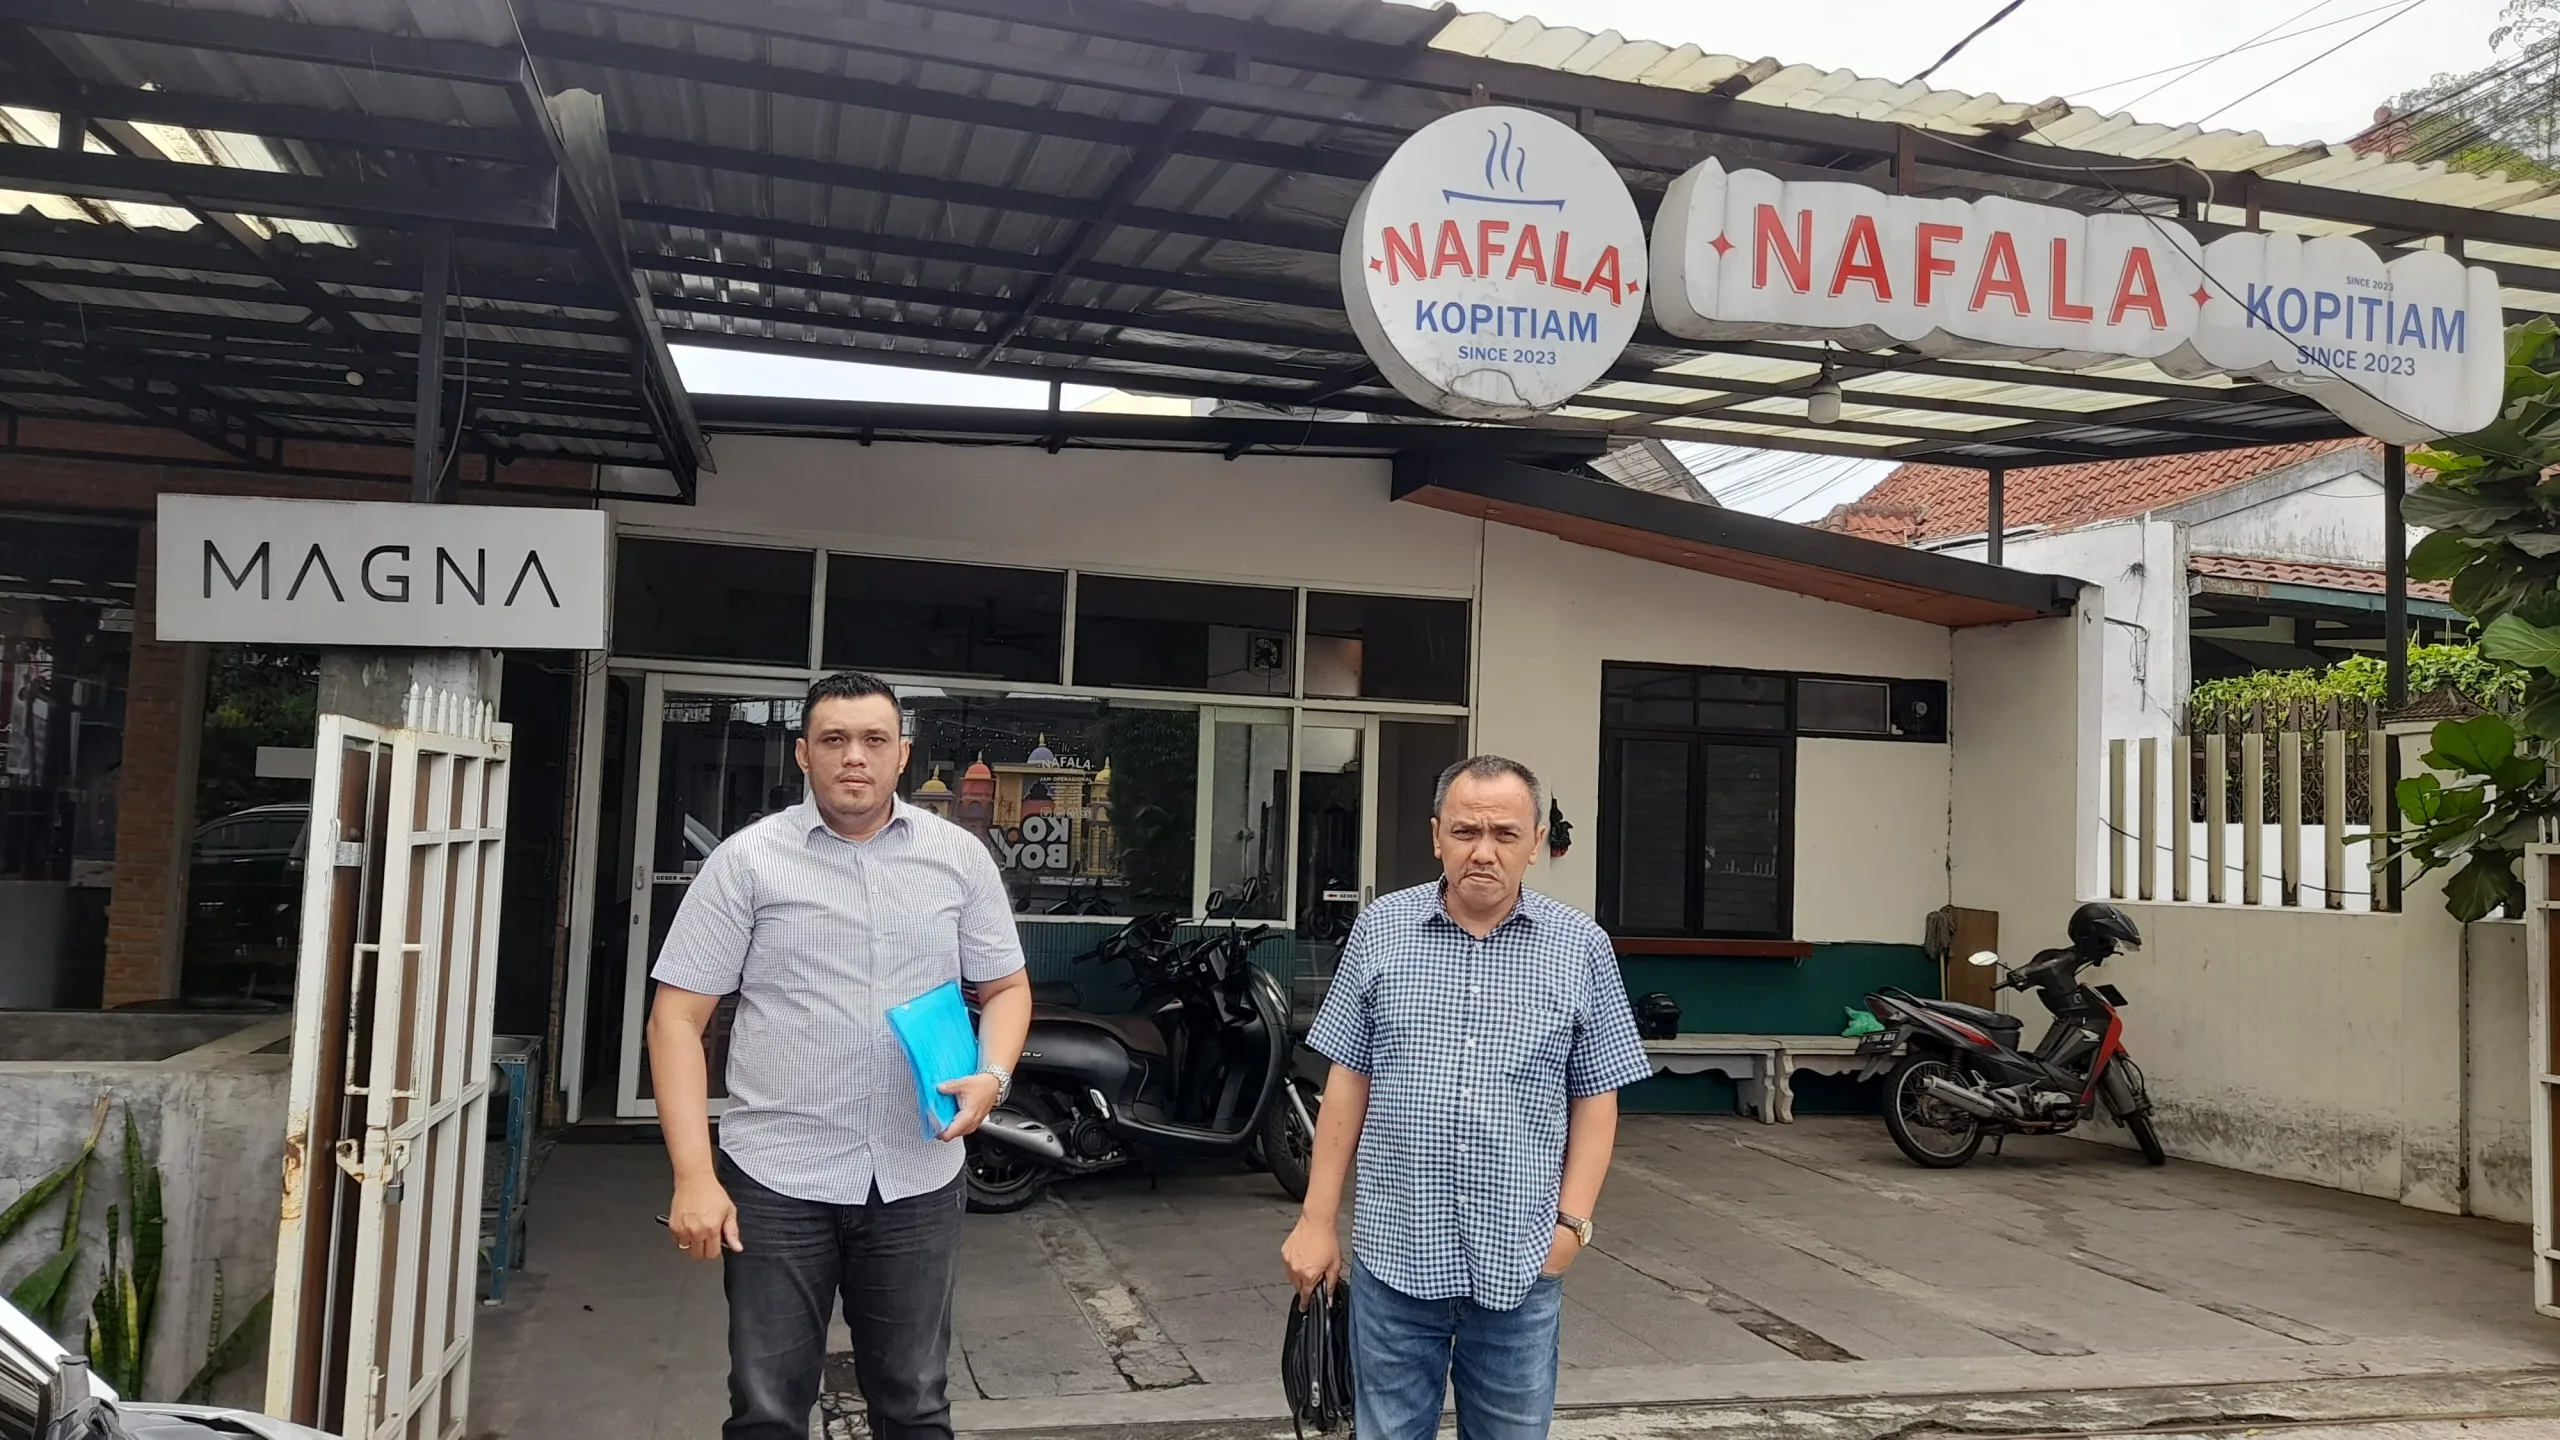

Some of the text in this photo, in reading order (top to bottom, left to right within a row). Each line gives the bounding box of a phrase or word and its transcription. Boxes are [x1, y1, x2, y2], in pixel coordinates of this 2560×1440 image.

[1382, 219, 1621, 307] NAFALA
[1752, 203, 2168, 331] NAFALA
[2345, 276, 2394, 291] SINCE 2023
[1415, 299, 1597, 343] KOPITIAM
[2246, 282, 2466, 354] KOPITIAM
[1457, 345, 1557, 365] SINCE 2023
[2296, 345, 2416, 377] SINCE 2023
[203, 539, 561, 608] MAGNA
[1041, 756, 1091, 771] NAFALA
